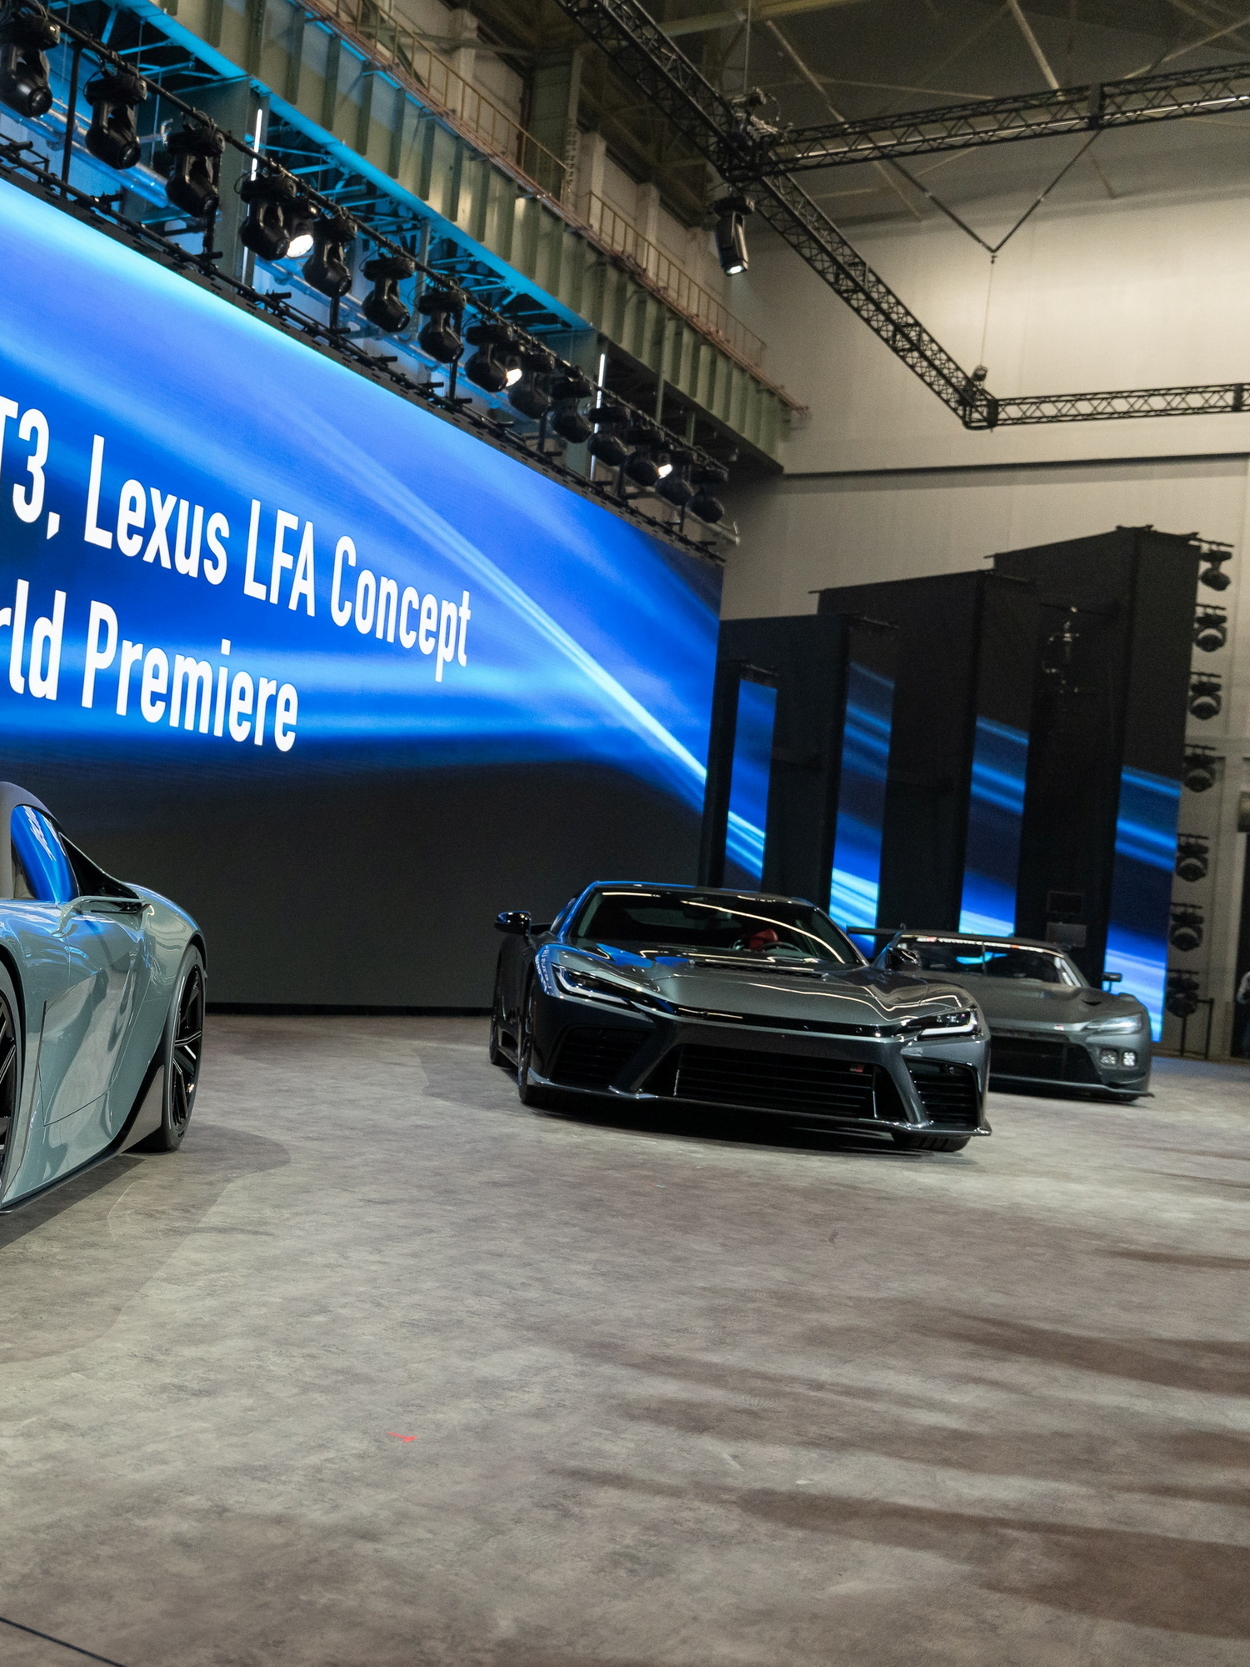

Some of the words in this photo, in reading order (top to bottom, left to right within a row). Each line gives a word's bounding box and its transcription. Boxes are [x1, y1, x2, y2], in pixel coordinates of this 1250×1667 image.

[84, 434, 230, 586] Lexus
[243, 499, 315, 617] LFA
[330, 535, 472, 682] Concept
[81, 600, 299, 752] Premiere
